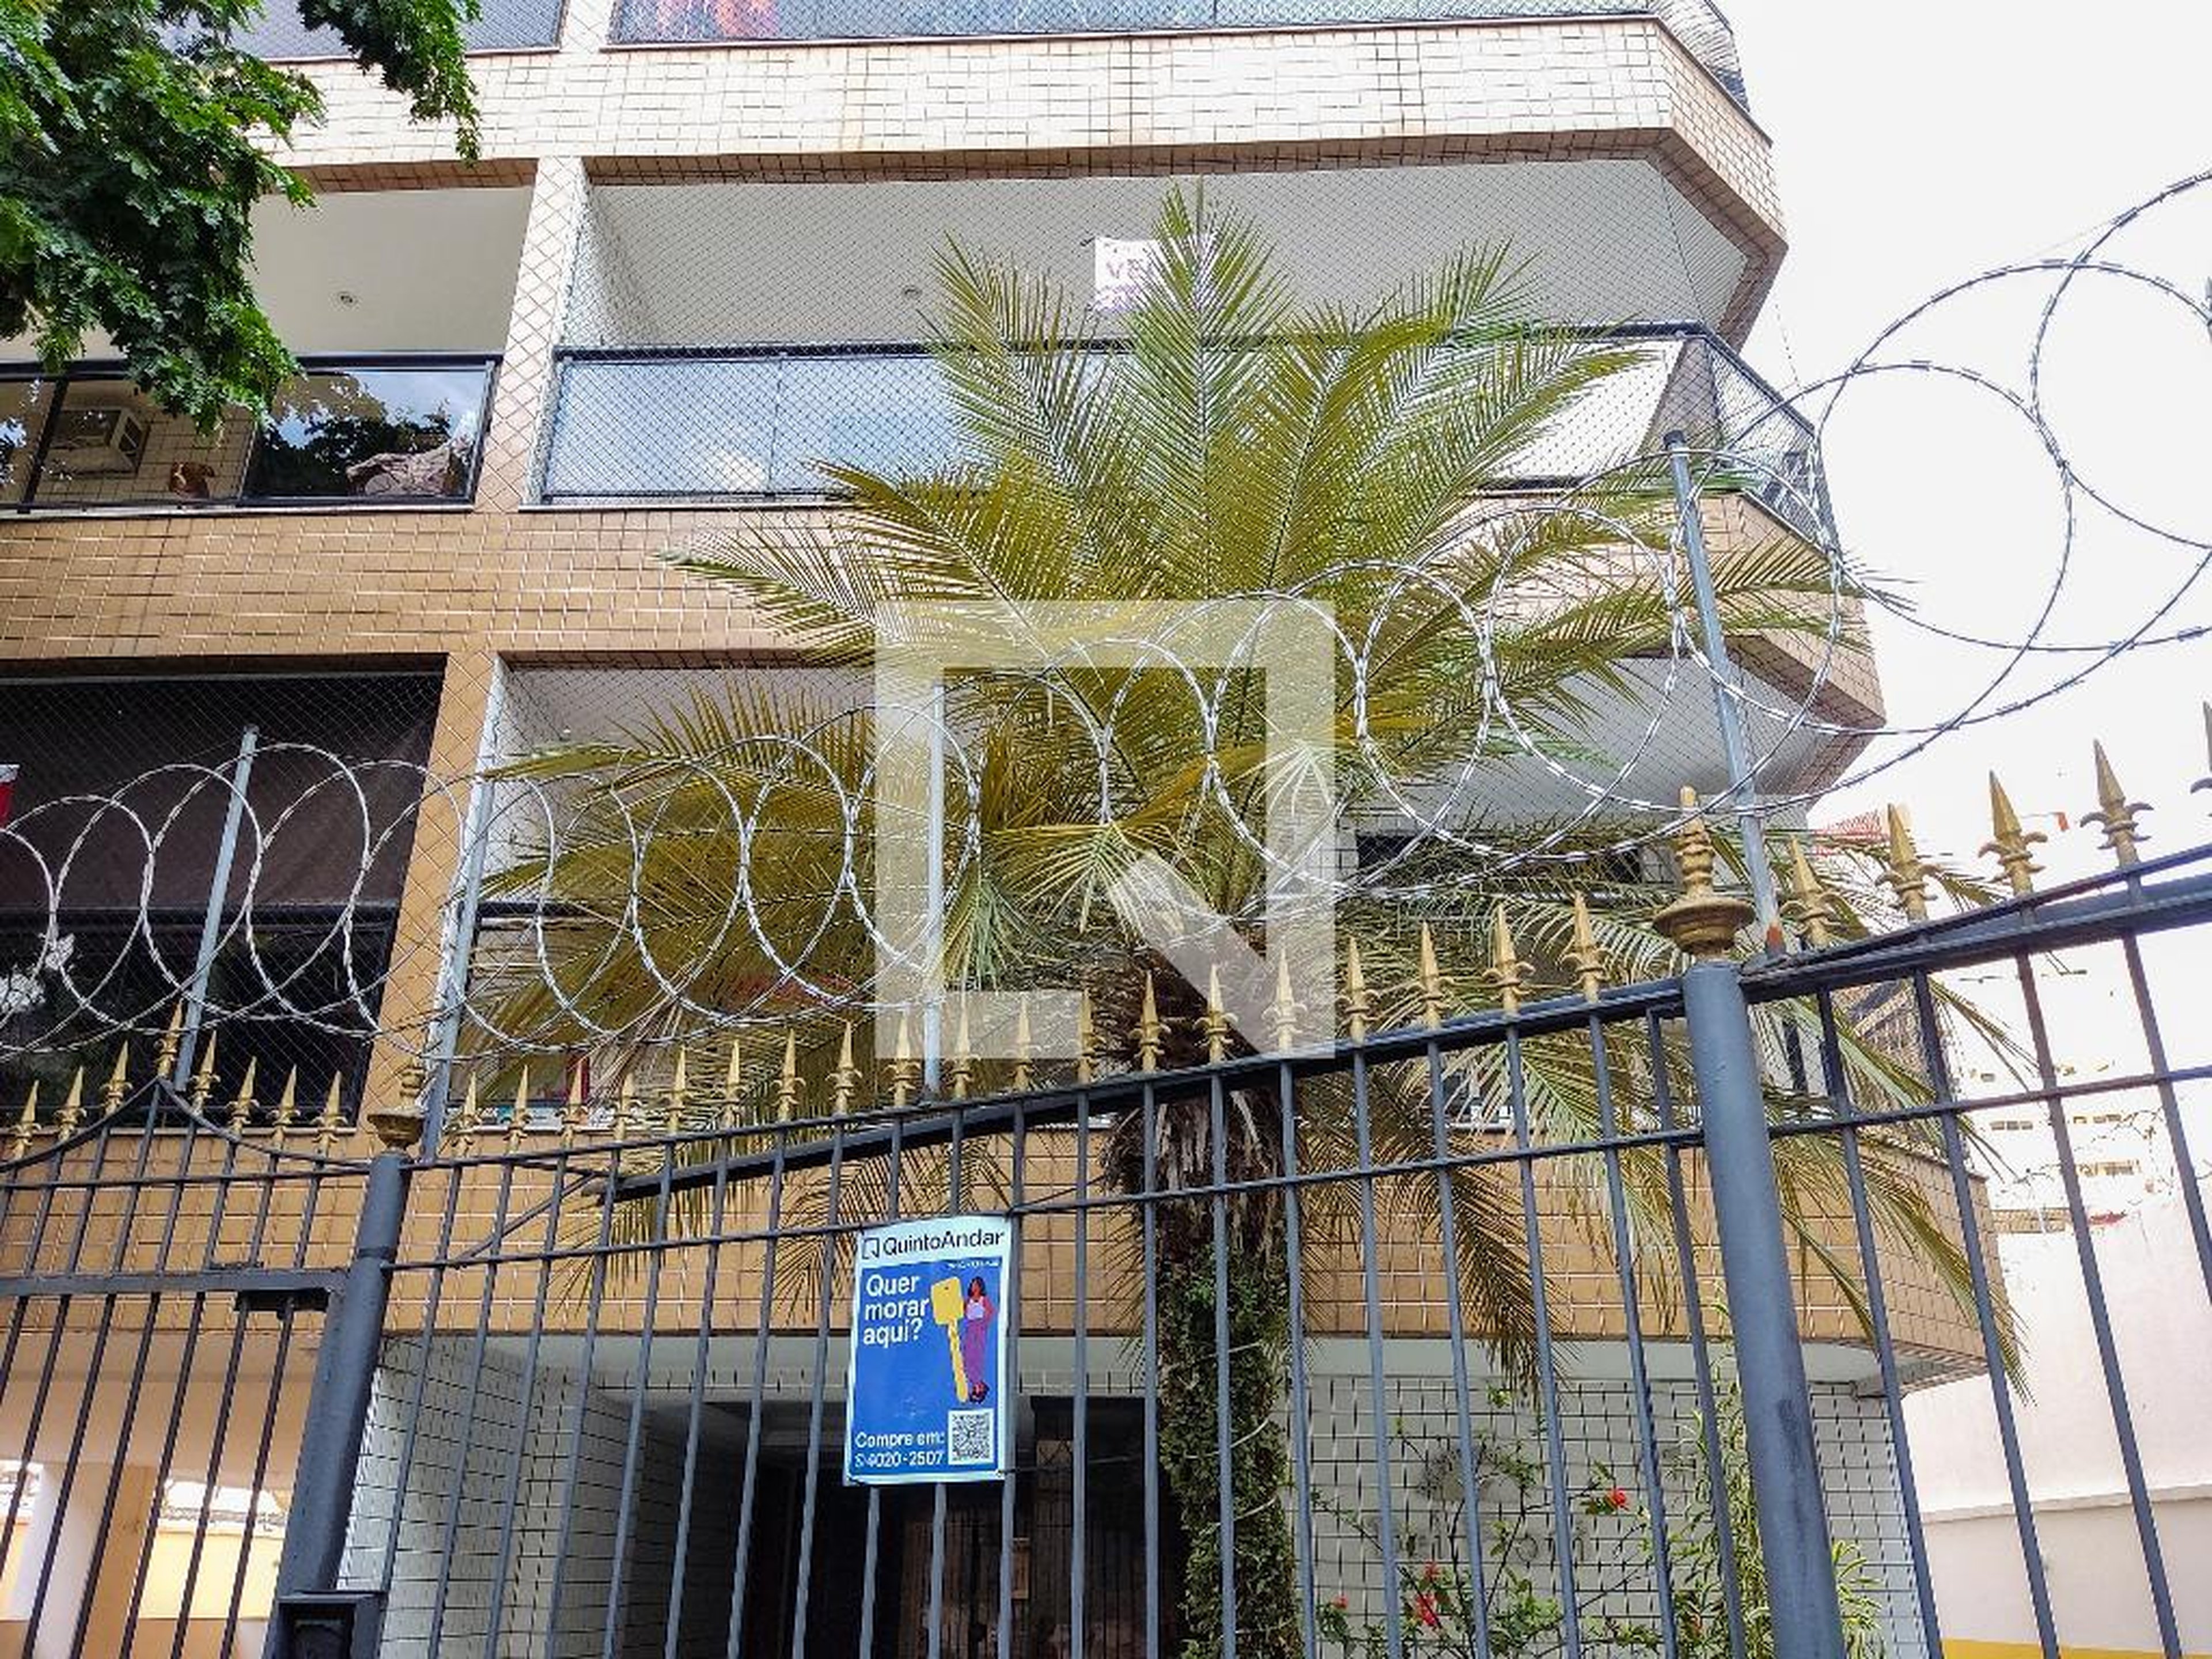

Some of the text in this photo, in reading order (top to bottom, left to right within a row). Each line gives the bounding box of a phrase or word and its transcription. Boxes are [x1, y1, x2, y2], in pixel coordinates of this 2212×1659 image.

[883, 1228, 1005, 1256] QuintoAndar
[866, 1274, 921, 1297] Quer
[865, 1297, 930, 1321] morar
[863, 1317, 923, 1349] aqui?
[855, 1431, 913, 1450] Compre
